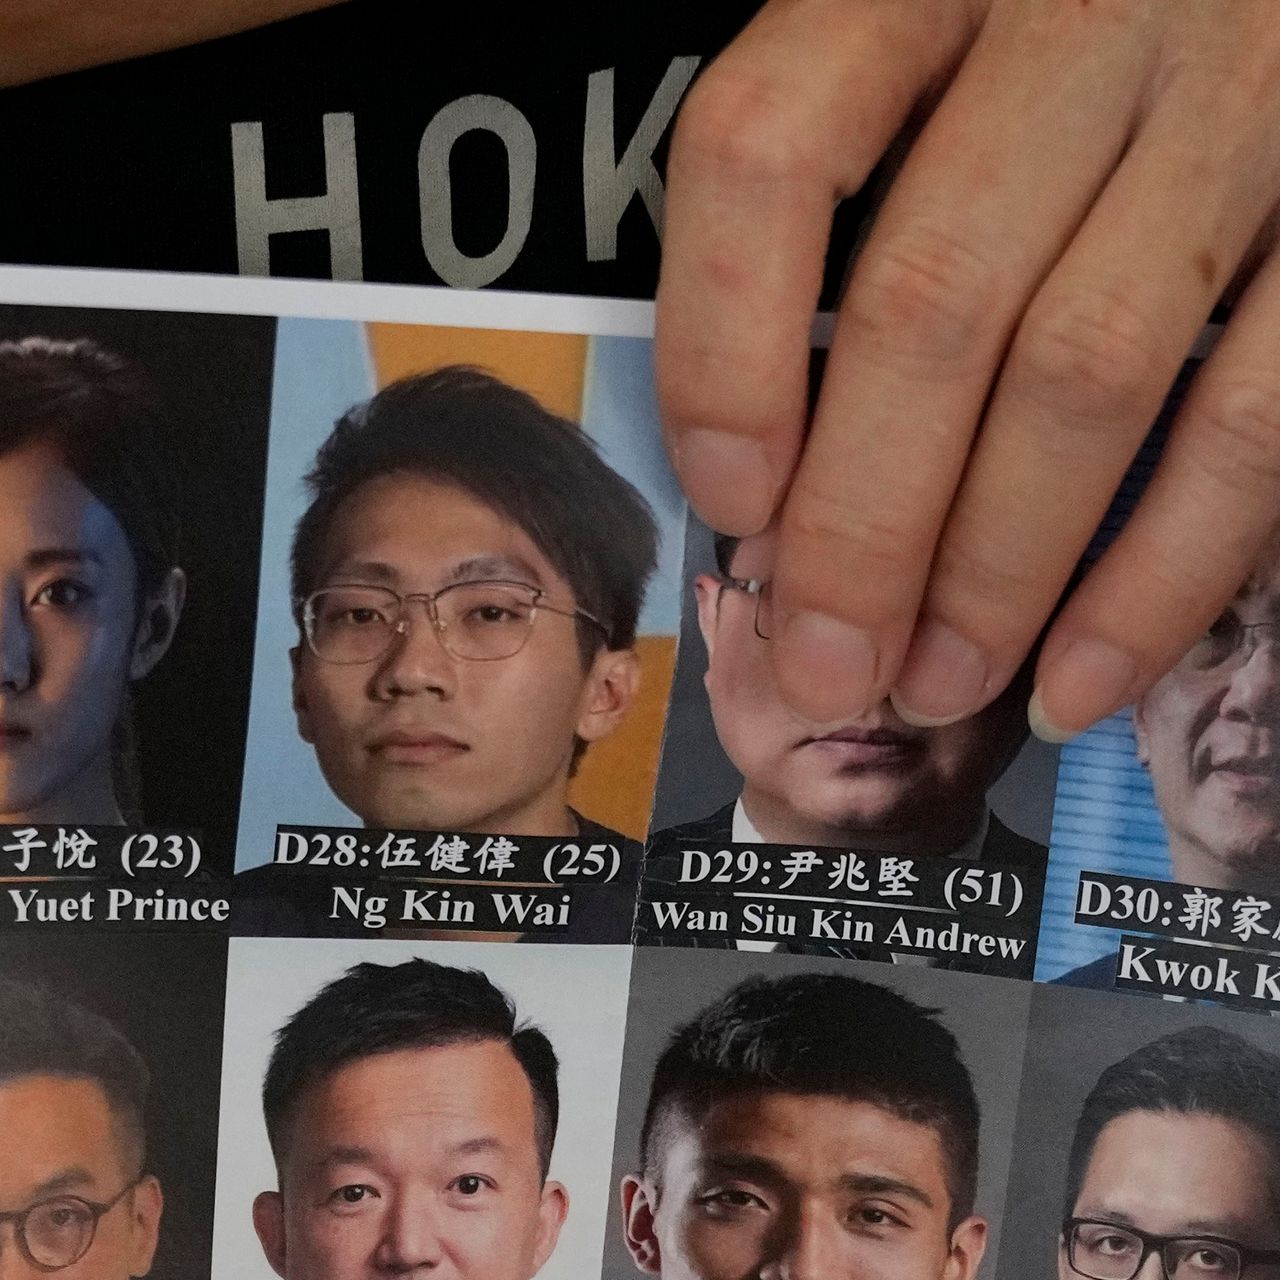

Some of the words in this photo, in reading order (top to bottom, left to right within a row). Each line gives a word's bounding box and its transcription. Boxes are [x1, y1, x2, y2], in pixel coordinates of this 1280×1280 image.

[230, 56, 700, 290] HOK
[120, 832, 201, 878] (23)
[276, 830, 521, 874] D28:伍健偉
[542, 841, 622, 885] (25)
[9, 891, 94, 924] Yuet
[106, 886, 230, 923] Prince
[329, 886, 387, 929] Ng
[402, 889, 475, 925] Kin
[493, 893, 571, 926] Wai
[678, 848, 921, 898] D29:尹兆堅
[943, 866, 1024, 917] (51)
[652, 901, 728, 933] Wan
[741, 906, 801, 940] Siu
[813, 910, 875, 945] Kin
[884, 917, 1026, 961] Andrew
[1118, 945, 1238, 995] Kwok
